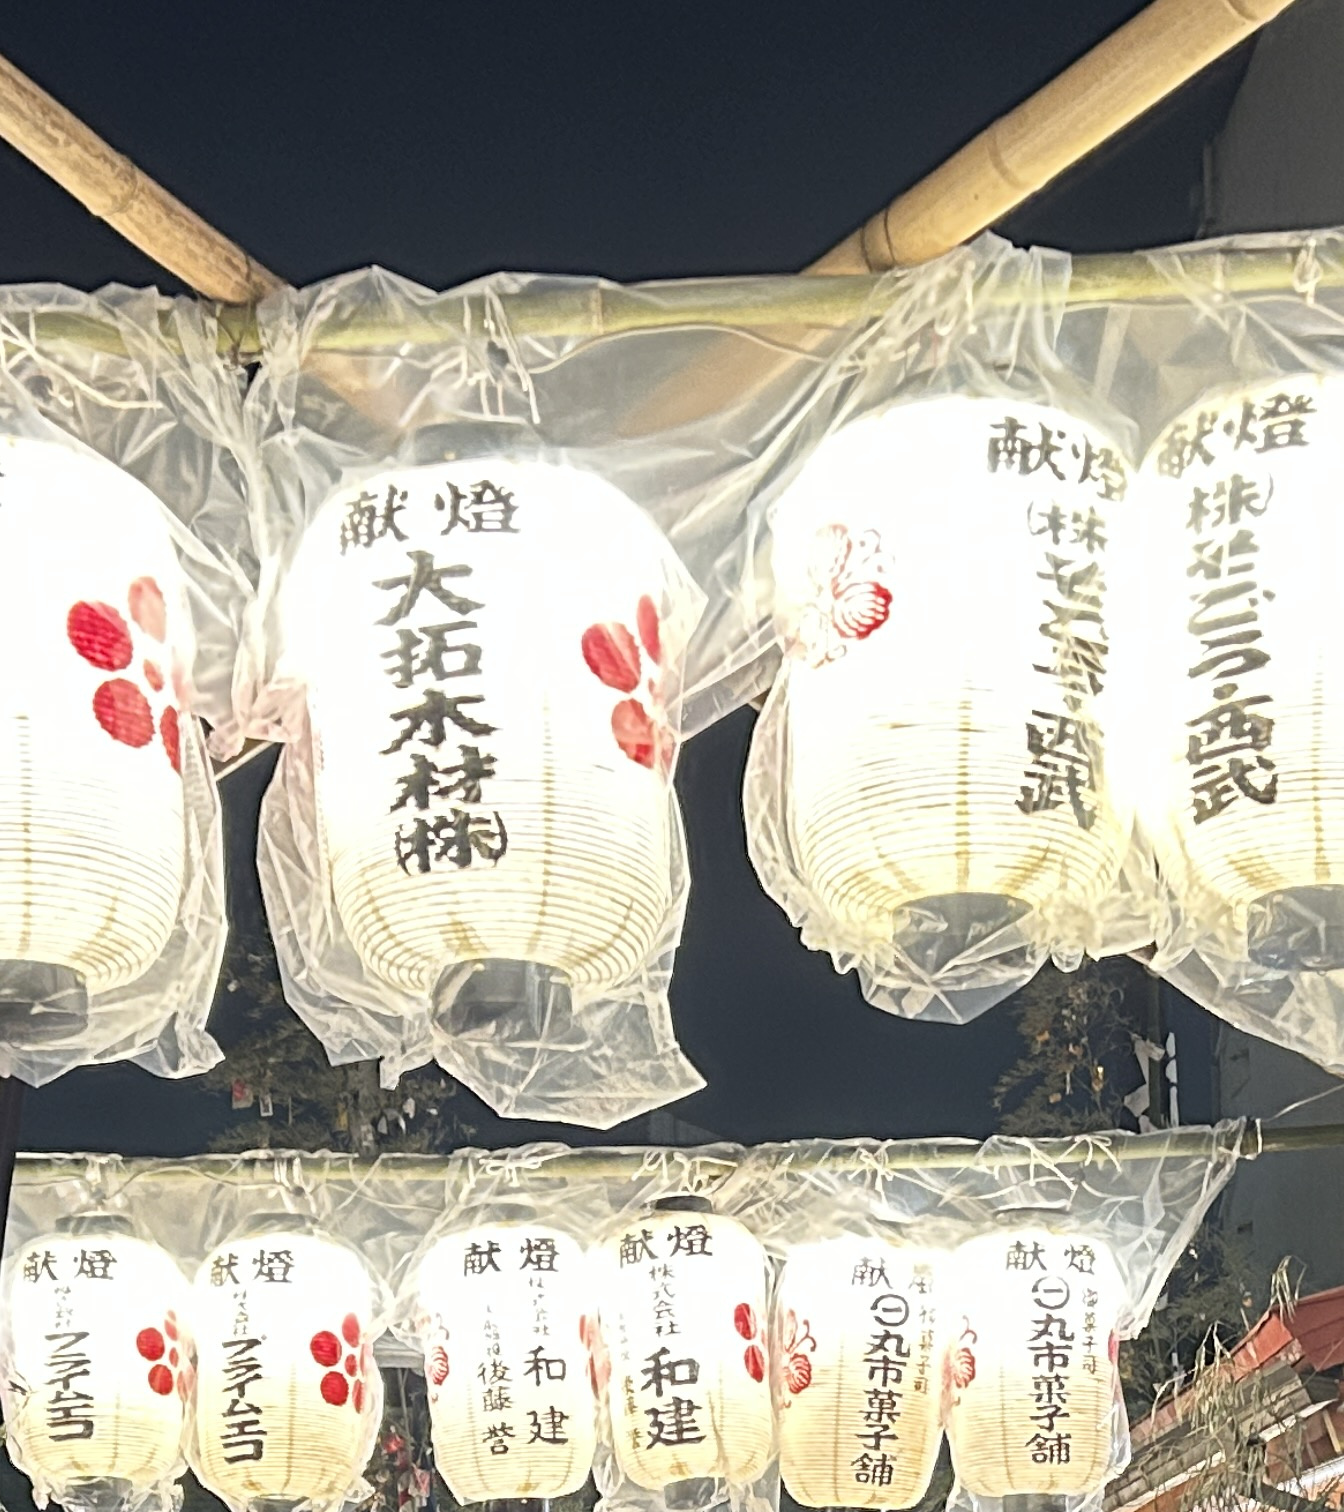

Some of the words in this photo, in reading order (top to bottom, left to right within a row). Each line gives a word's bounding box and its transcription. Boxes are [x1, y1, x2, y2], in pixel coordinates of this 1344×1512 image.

[1156, 392, 1317, 478] 献燈
[987, 416, 1129, 502] 献燈
[340, 480, 520, 555] 献燈
[23, 1249, 117, 1283] 献燈
[463, 1238, 560, 1276] 献燈
[619, 1224, 714, 1269] 献燈
[1006, 1240, 1097, 1275] 献燈
[210, 1249, 295, 1287] 献燈
